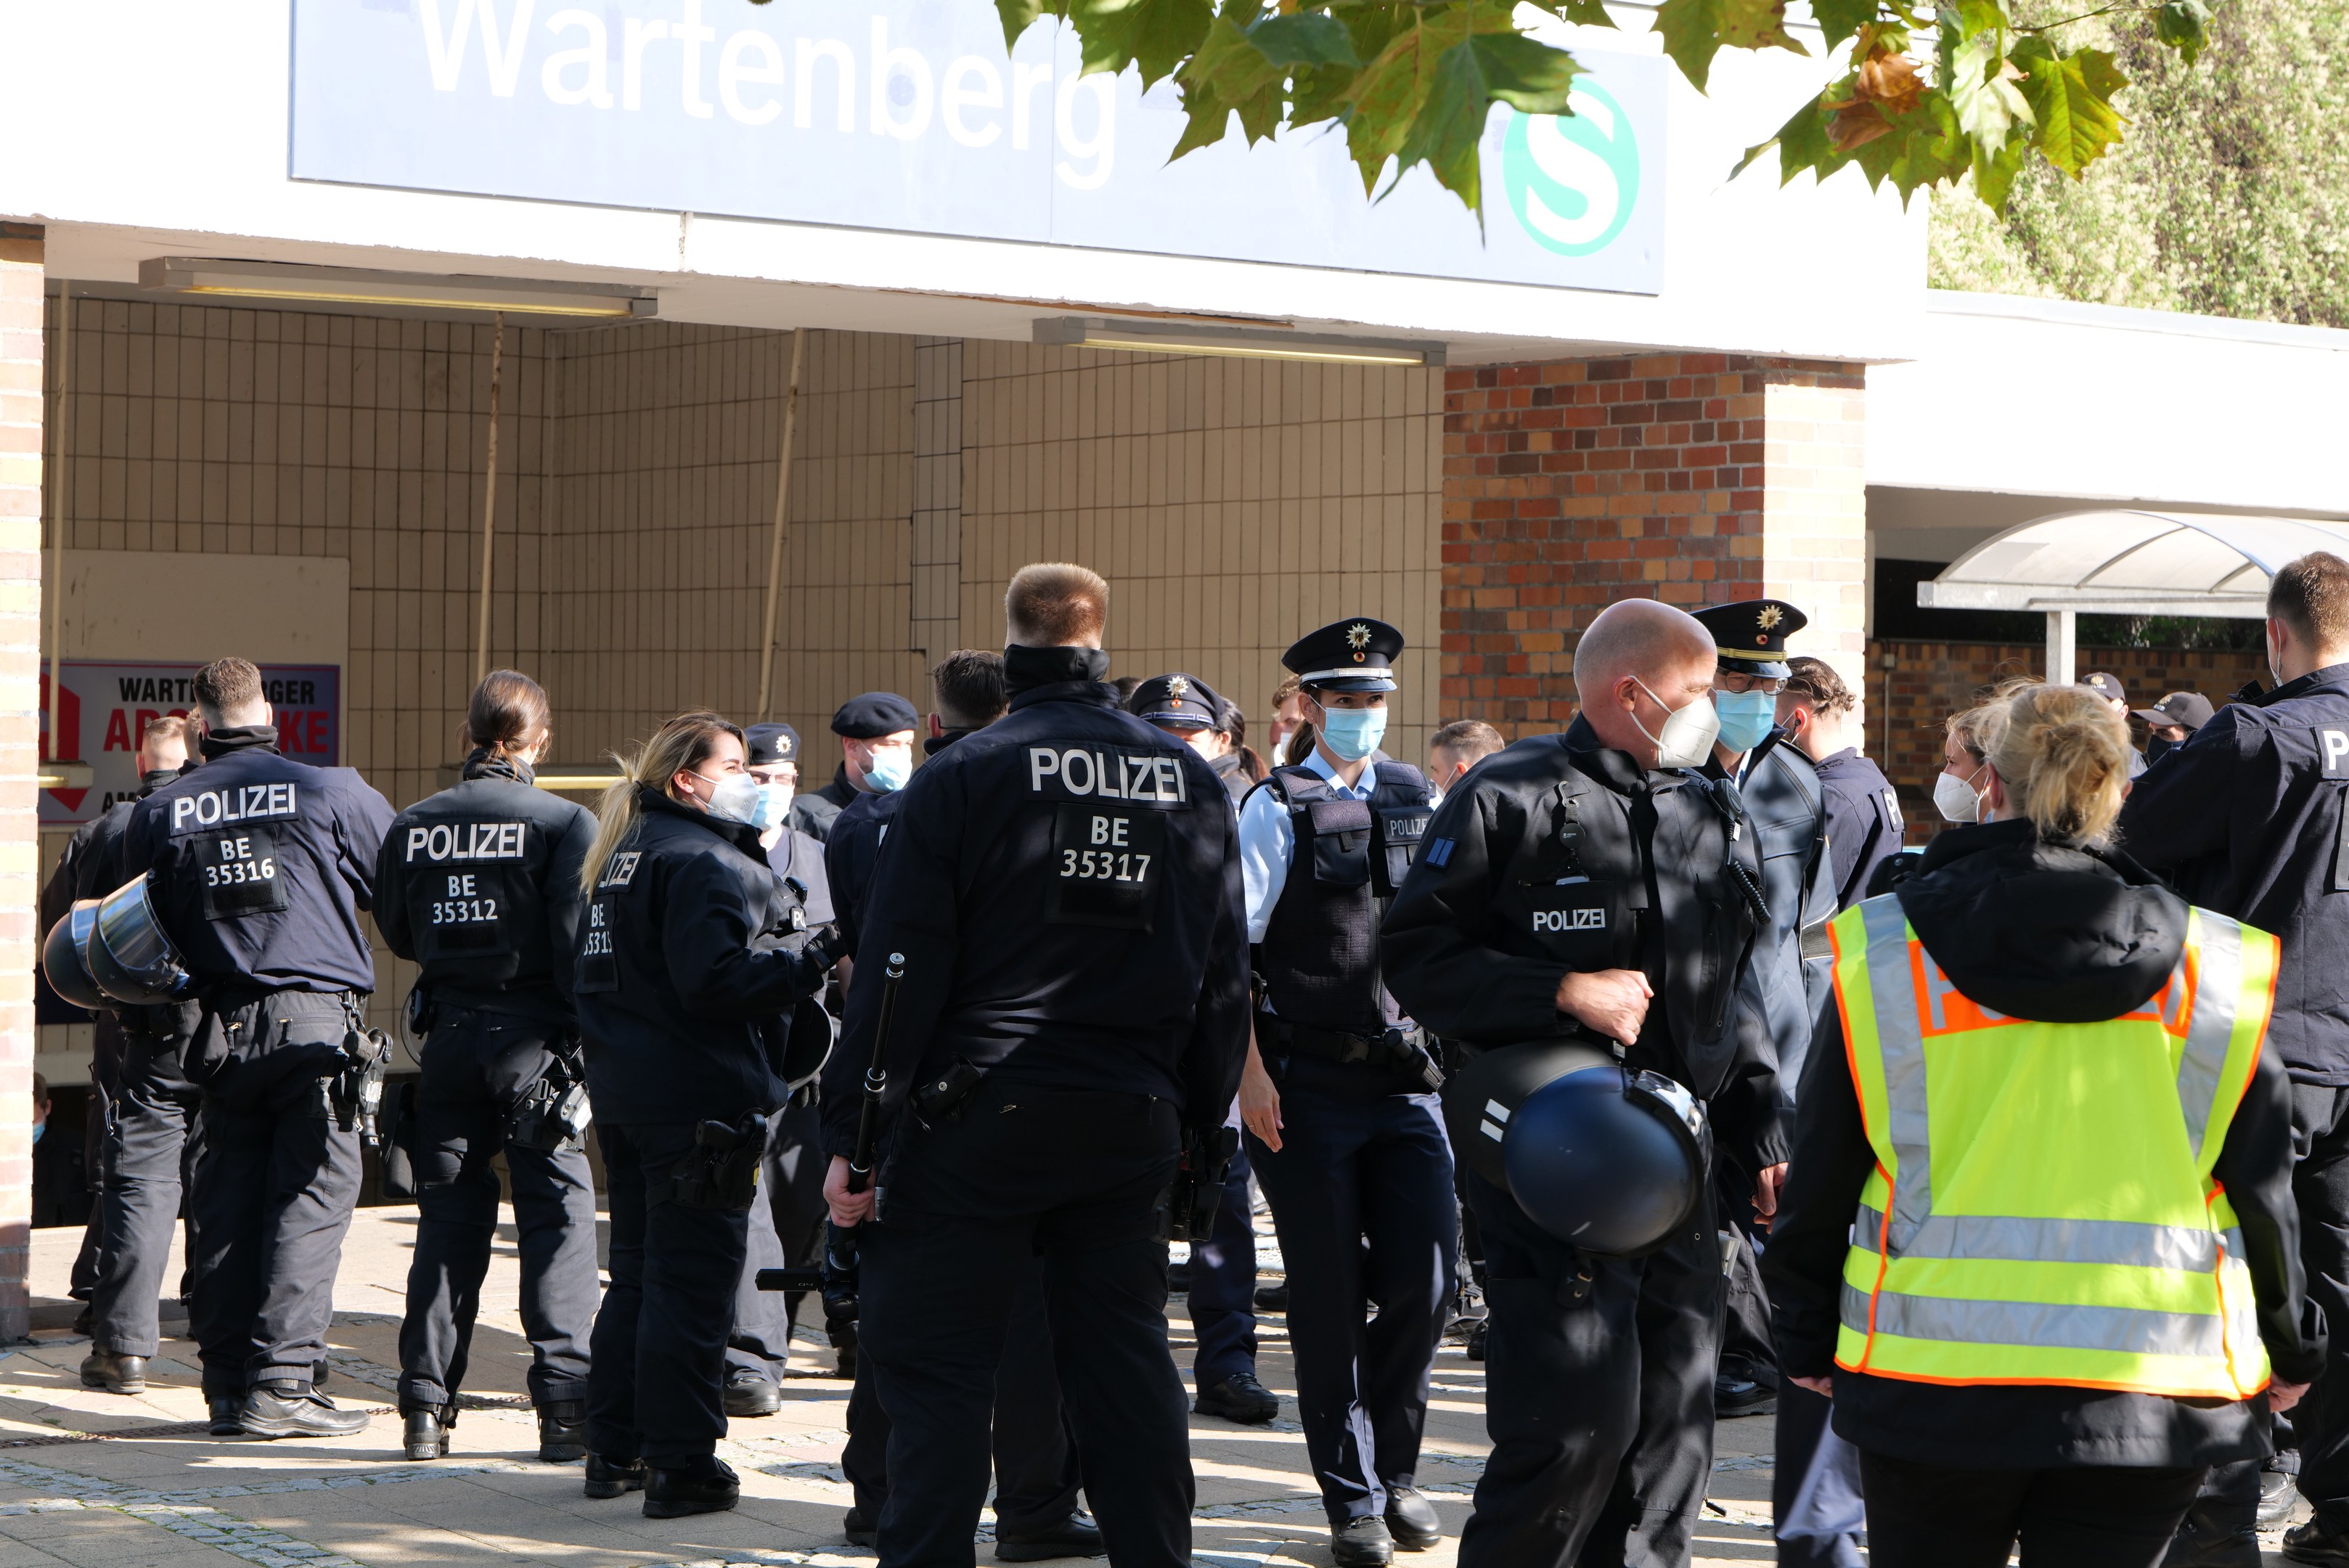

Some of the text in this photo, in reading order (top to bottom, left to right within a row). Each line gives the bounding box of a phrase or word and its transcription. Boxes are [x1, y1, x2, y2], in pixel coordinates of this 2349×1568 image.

[418, 0, 1116, 190] Wartenberg
[1029, 748, 1186, 802] POLIZEI
[174, 783, 295, 829] POLIZEI
[406, 823, 526, 862] POLIZEI
[1091, 815, 1129, 846] BE
[220, 837, 252, 861] BE
[206, 857, 275, 886] 35316
[1060, 849, 1151, 882] 35317
[448, 874, 477, 897] BE
[433, 899, 498, 924] 35312
[591, 903, 605, 928] BE
[1533, 908, 1606, 931] POLIZEI
